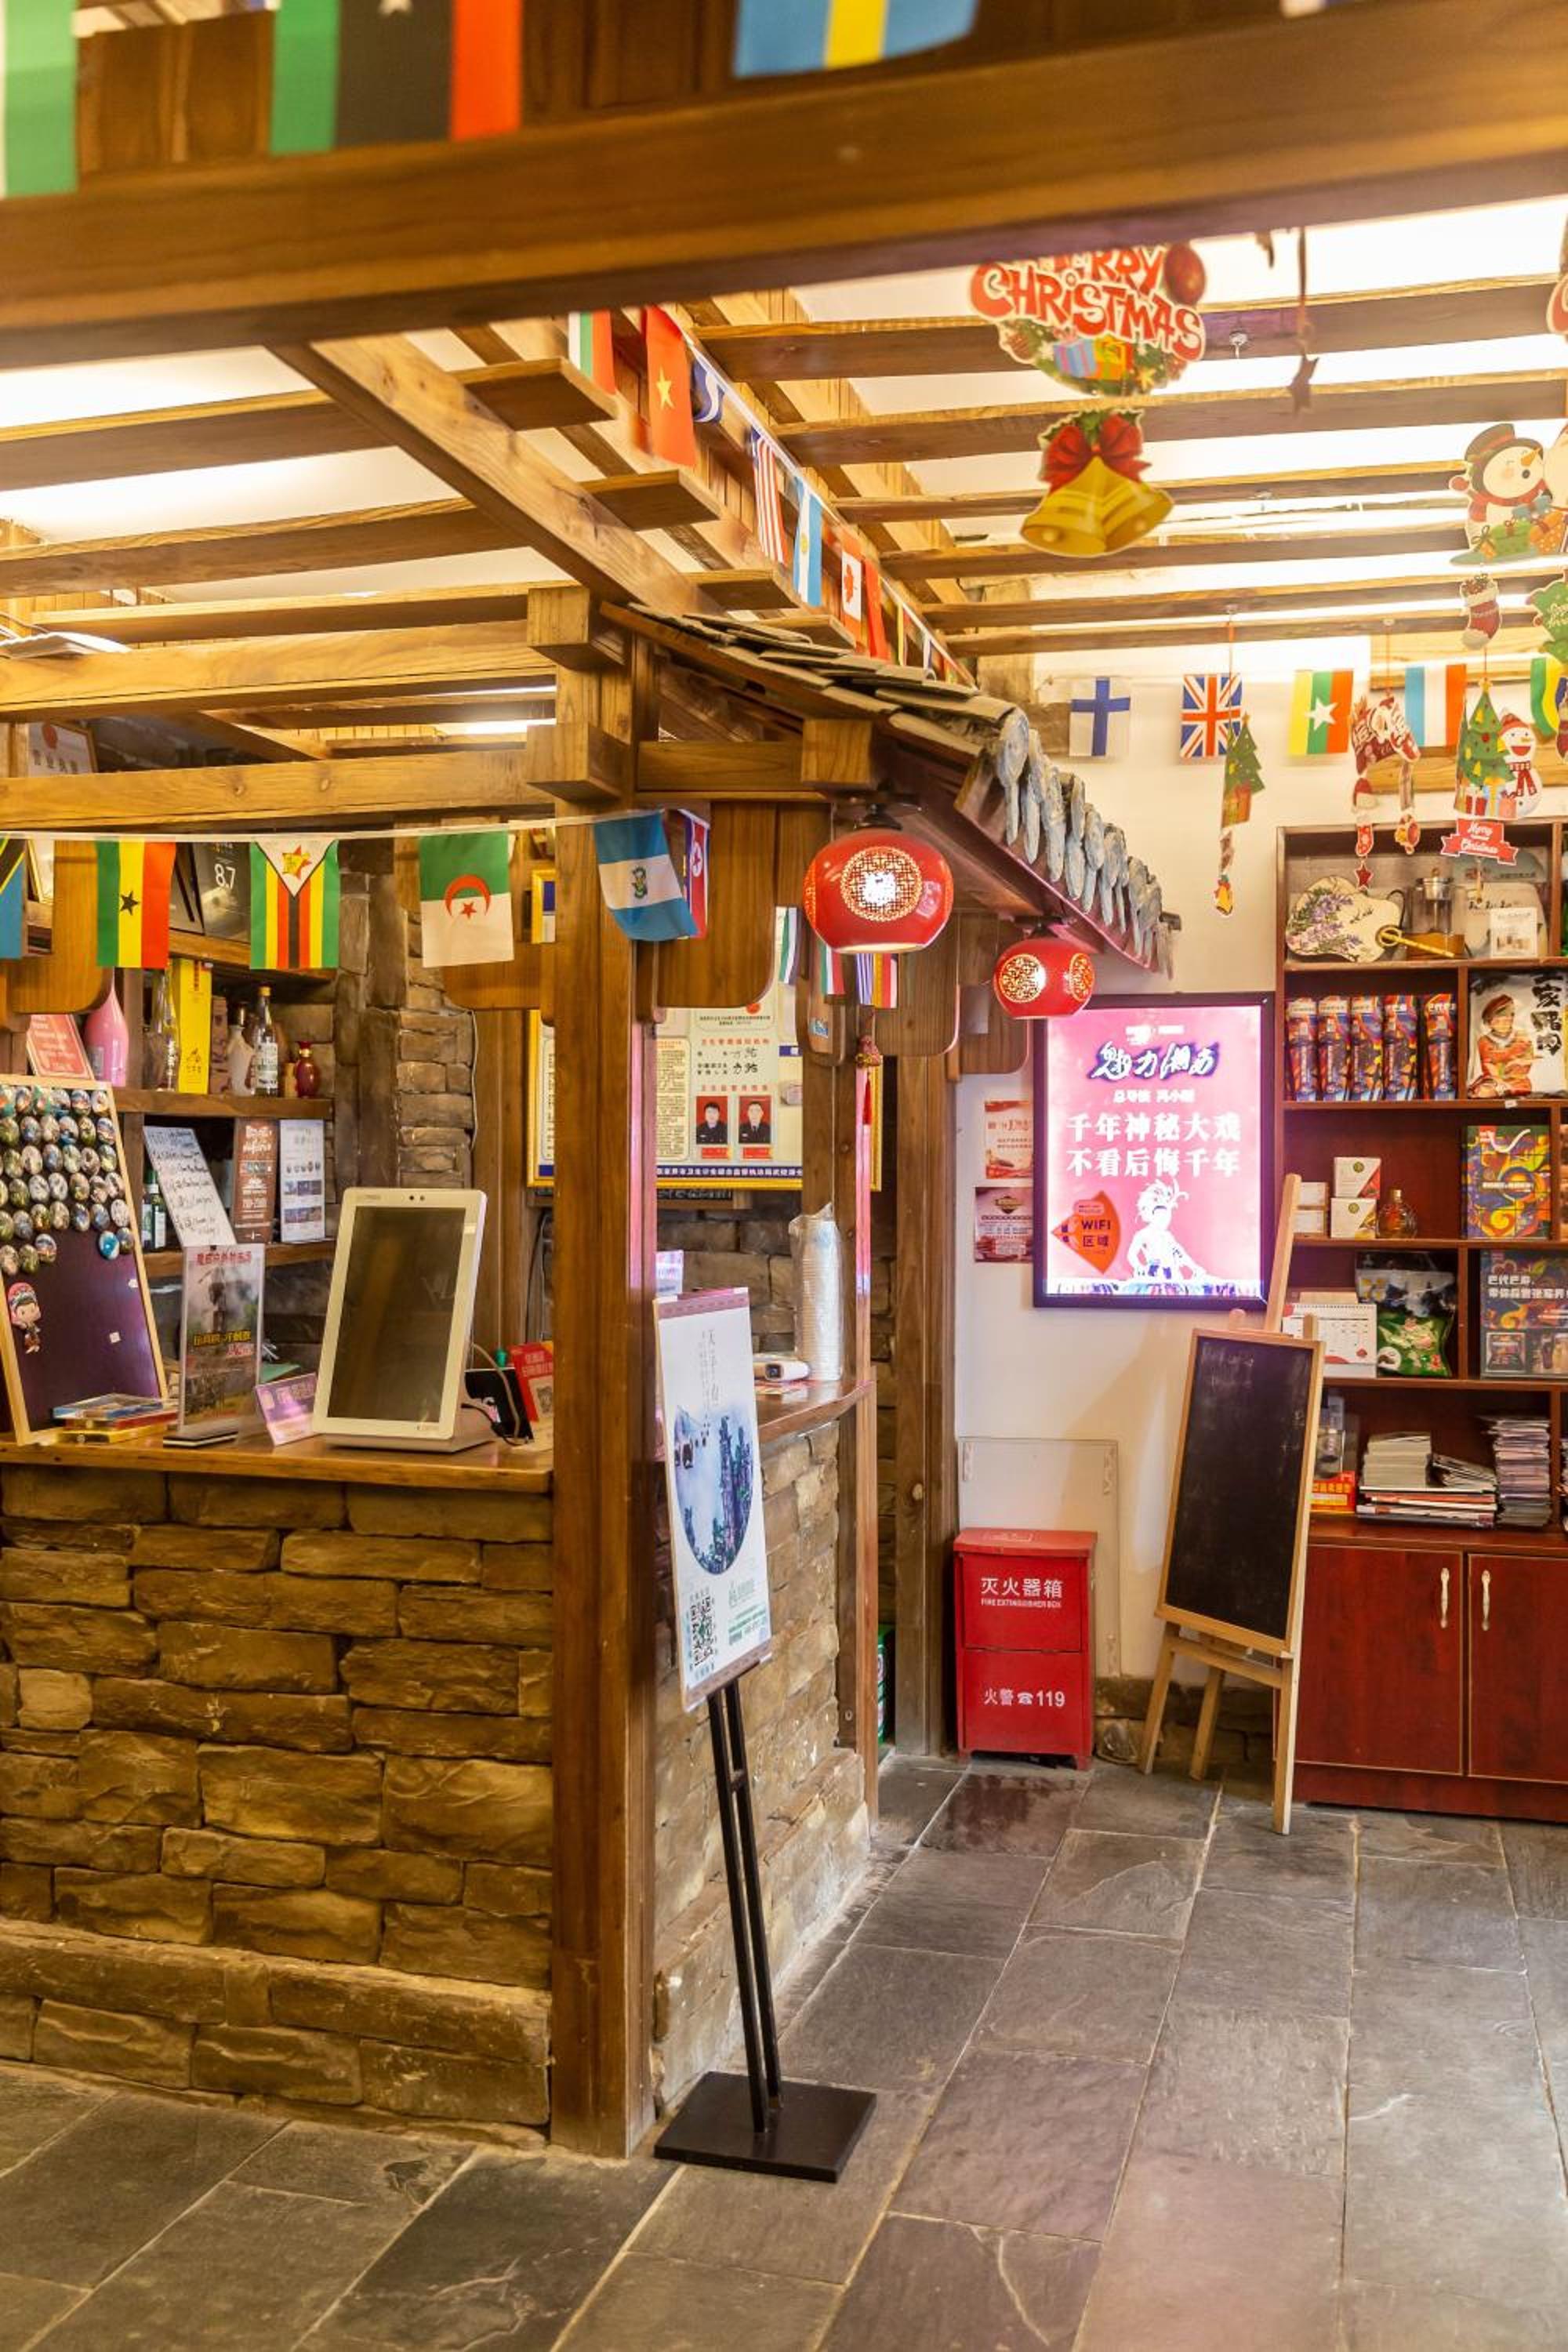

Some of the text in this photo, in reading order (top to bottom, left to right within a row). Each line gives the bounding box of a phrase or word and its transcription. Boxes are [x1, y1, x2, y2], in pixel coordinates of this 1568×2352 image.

[214, 863, 236, 889] 8.7
[1066, 1112, 1241, 1142] 千年神秘大戏
[1066, 1149, 1241, 1178] 不看后悔千年
[1081, 1219, 1111, 1230] WIFI
[1083, 1235, 1109, 1247] 区域
[981, 1577, 1063, 1599] 灭火器箱
[983, 1687, 1065, 1708] 火警 119
